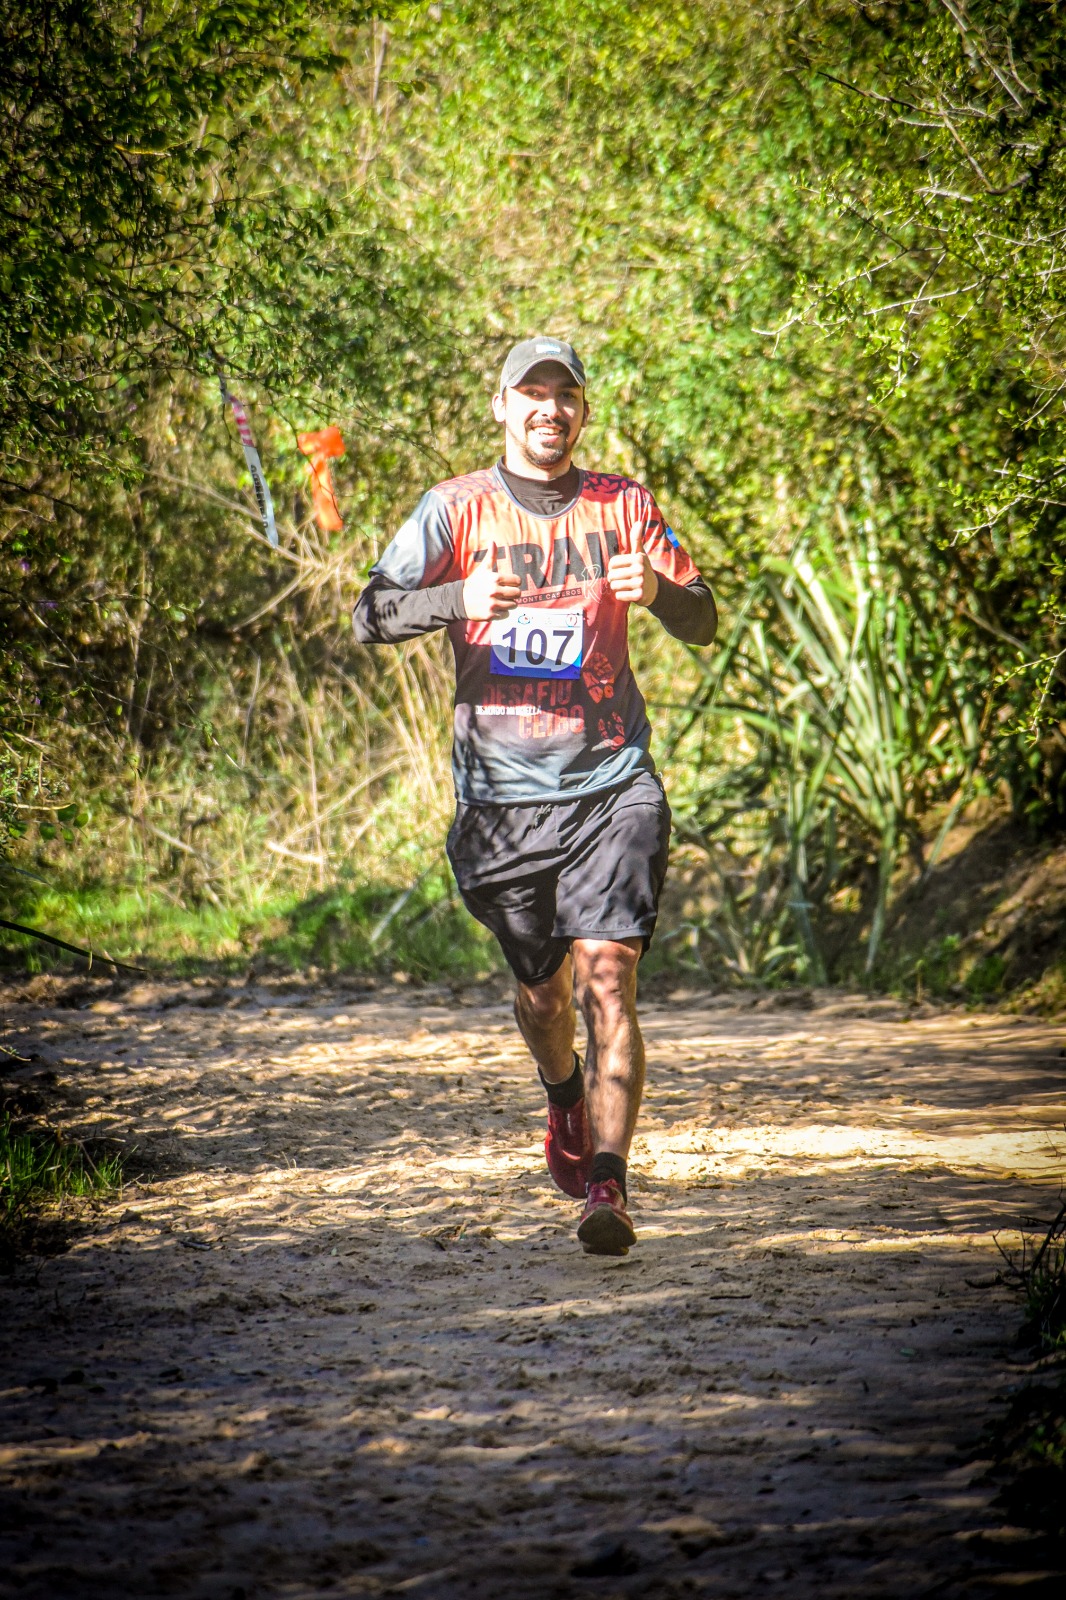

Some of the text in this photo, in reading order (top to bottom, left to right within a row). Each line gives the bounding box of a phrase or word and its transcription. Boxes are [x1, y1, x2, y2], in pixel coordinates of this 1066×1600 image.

[514, 588, 582, 605] MONTE CASEROS
[502, 627, 575, 666] 107
[518, 704, 585, 740] CEIBO
